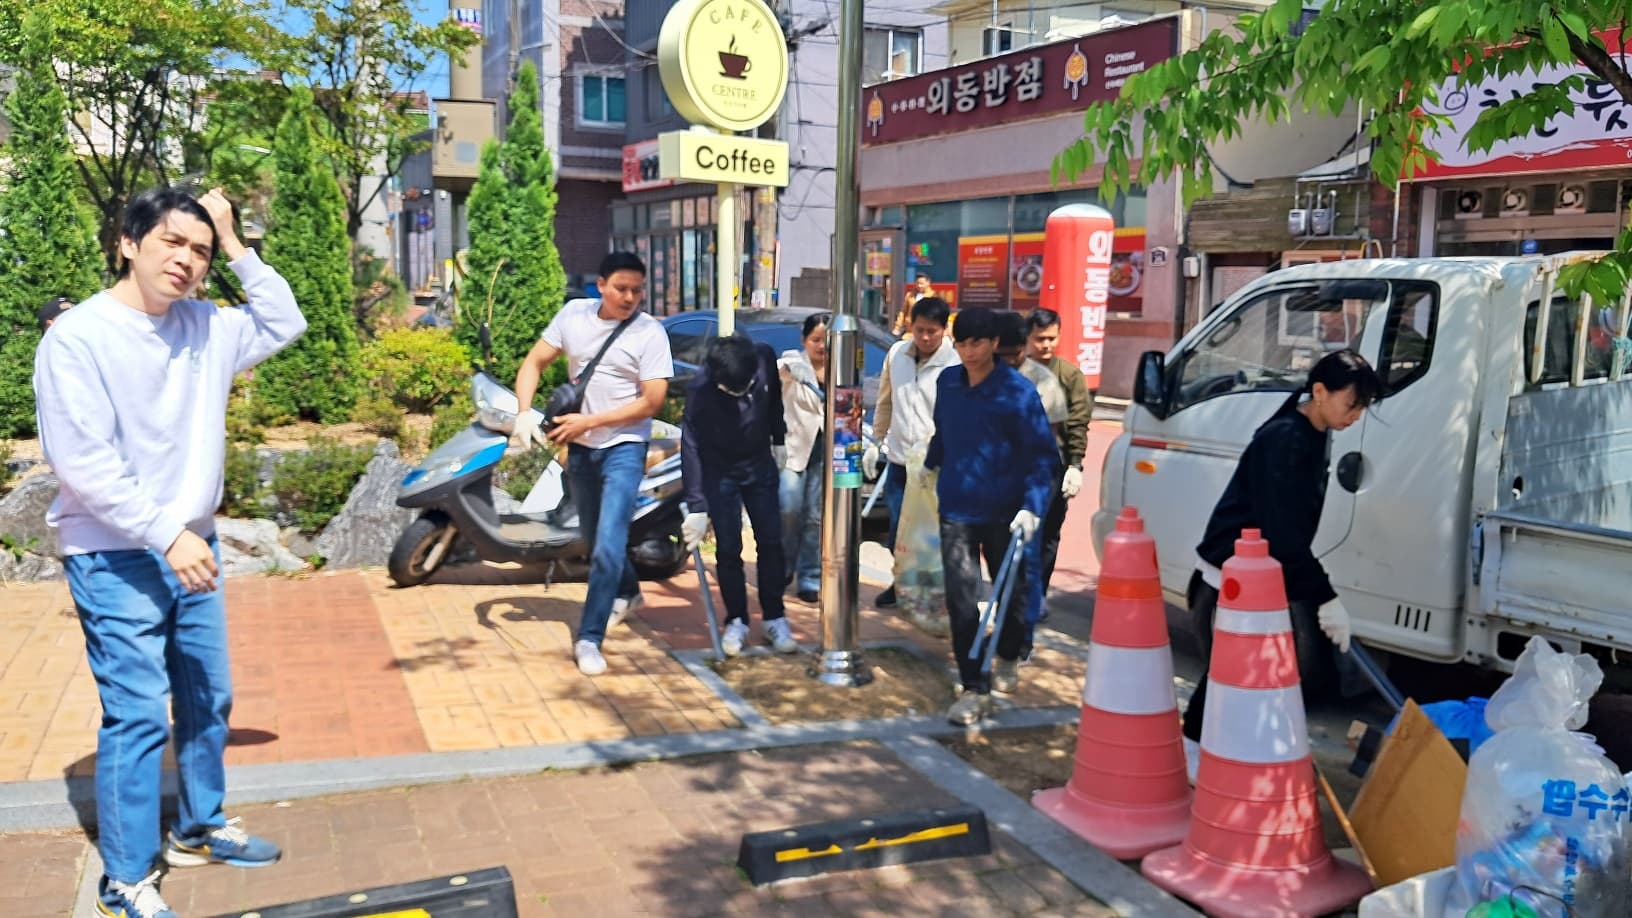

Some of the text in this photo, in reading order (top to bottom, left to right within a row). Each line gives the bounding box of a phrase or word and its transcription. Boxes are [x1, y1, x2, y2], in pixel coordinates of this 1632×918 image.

[709, 5, 763, 34] CAFE
[1104, 50, 1137, 64] Chinese
[1104, 61, 1145, 78] Restaurant
[926, 56, 1043, 116] 외동반점
[695, 145, 776, 175] Coffee
[1076, 229, 1114, 376] 외동반점
